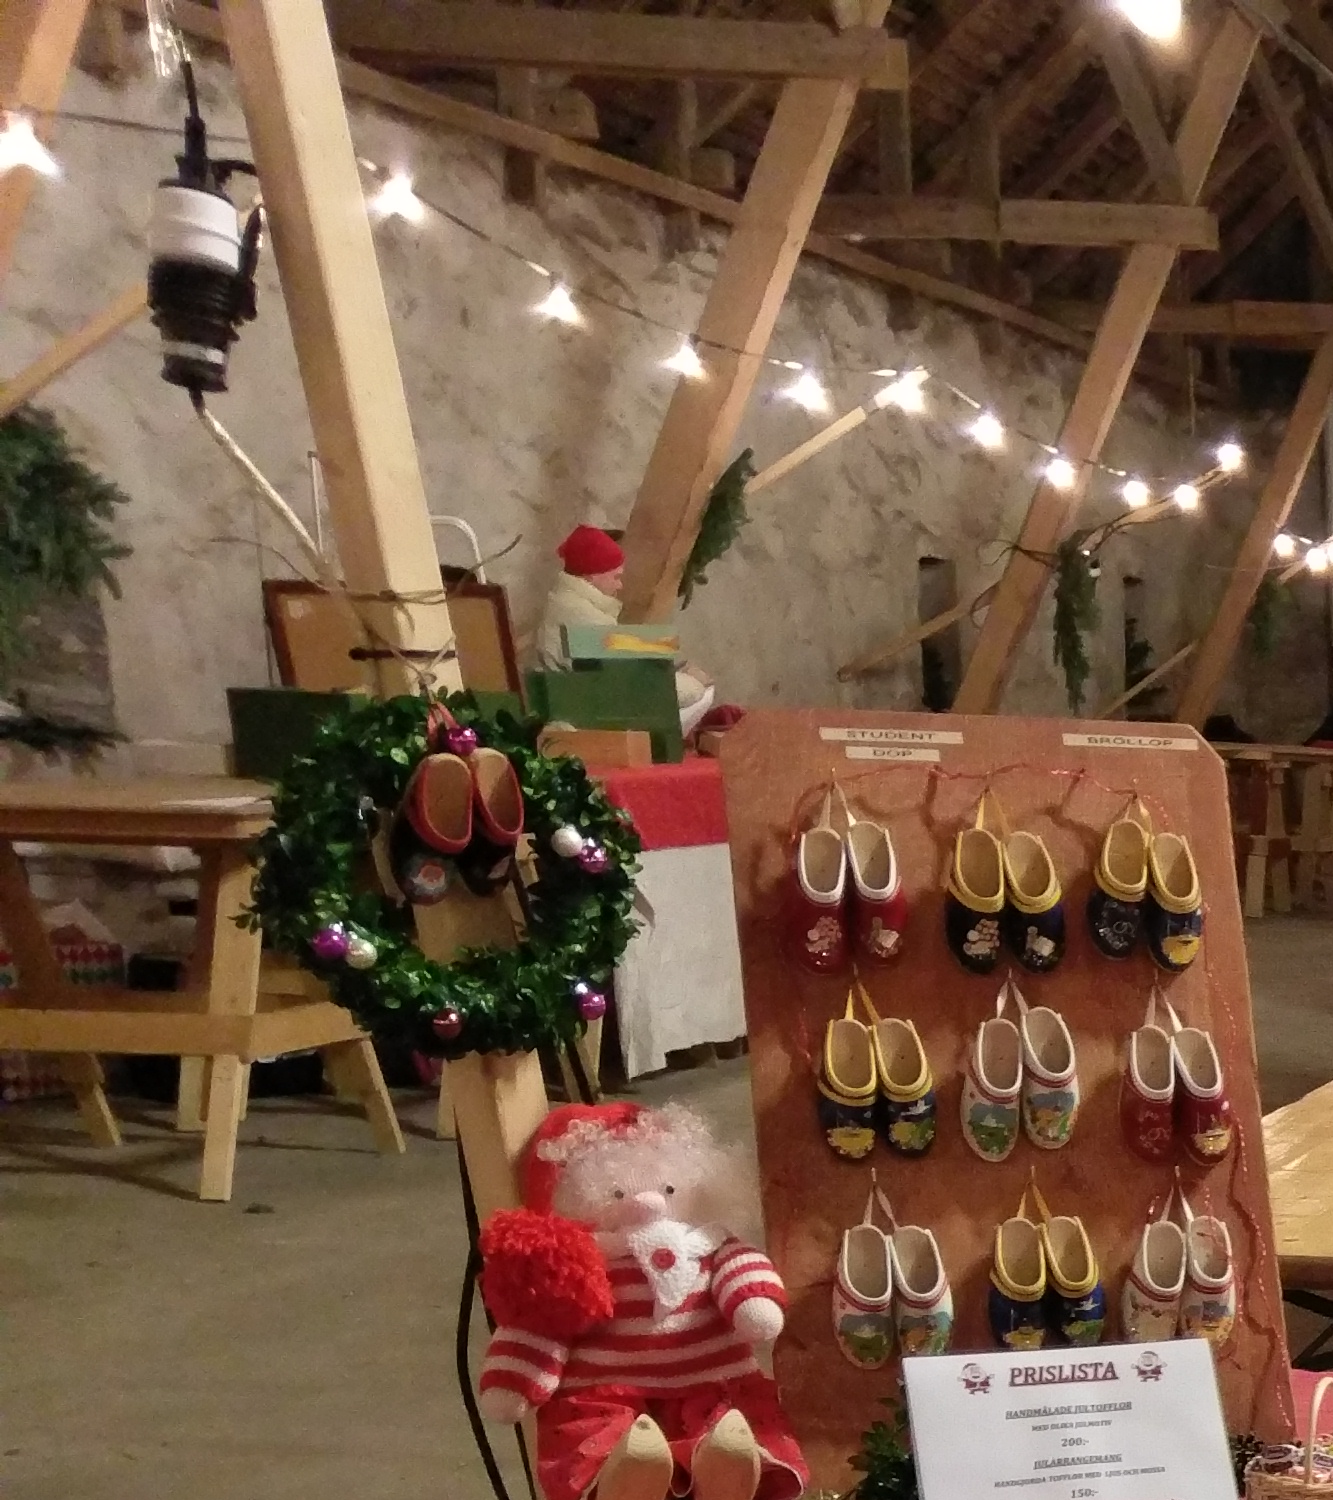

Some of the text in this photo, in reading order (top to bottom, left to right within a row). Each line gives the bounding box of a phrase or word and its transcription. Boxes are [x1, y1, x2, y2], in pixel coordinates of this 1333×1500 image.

[846, 729, 936, 741] STUDENT
[1086, 736, 1174, 747] BRÖLLOP
[872, 747, 913, 758] DOP
[1008, 1360, 1120, 1387] PRISLISTA
[1005, 1404, 1073, 1419] HANDMÅLADE
[1070, 1487, 1100, 1499] 150:-
